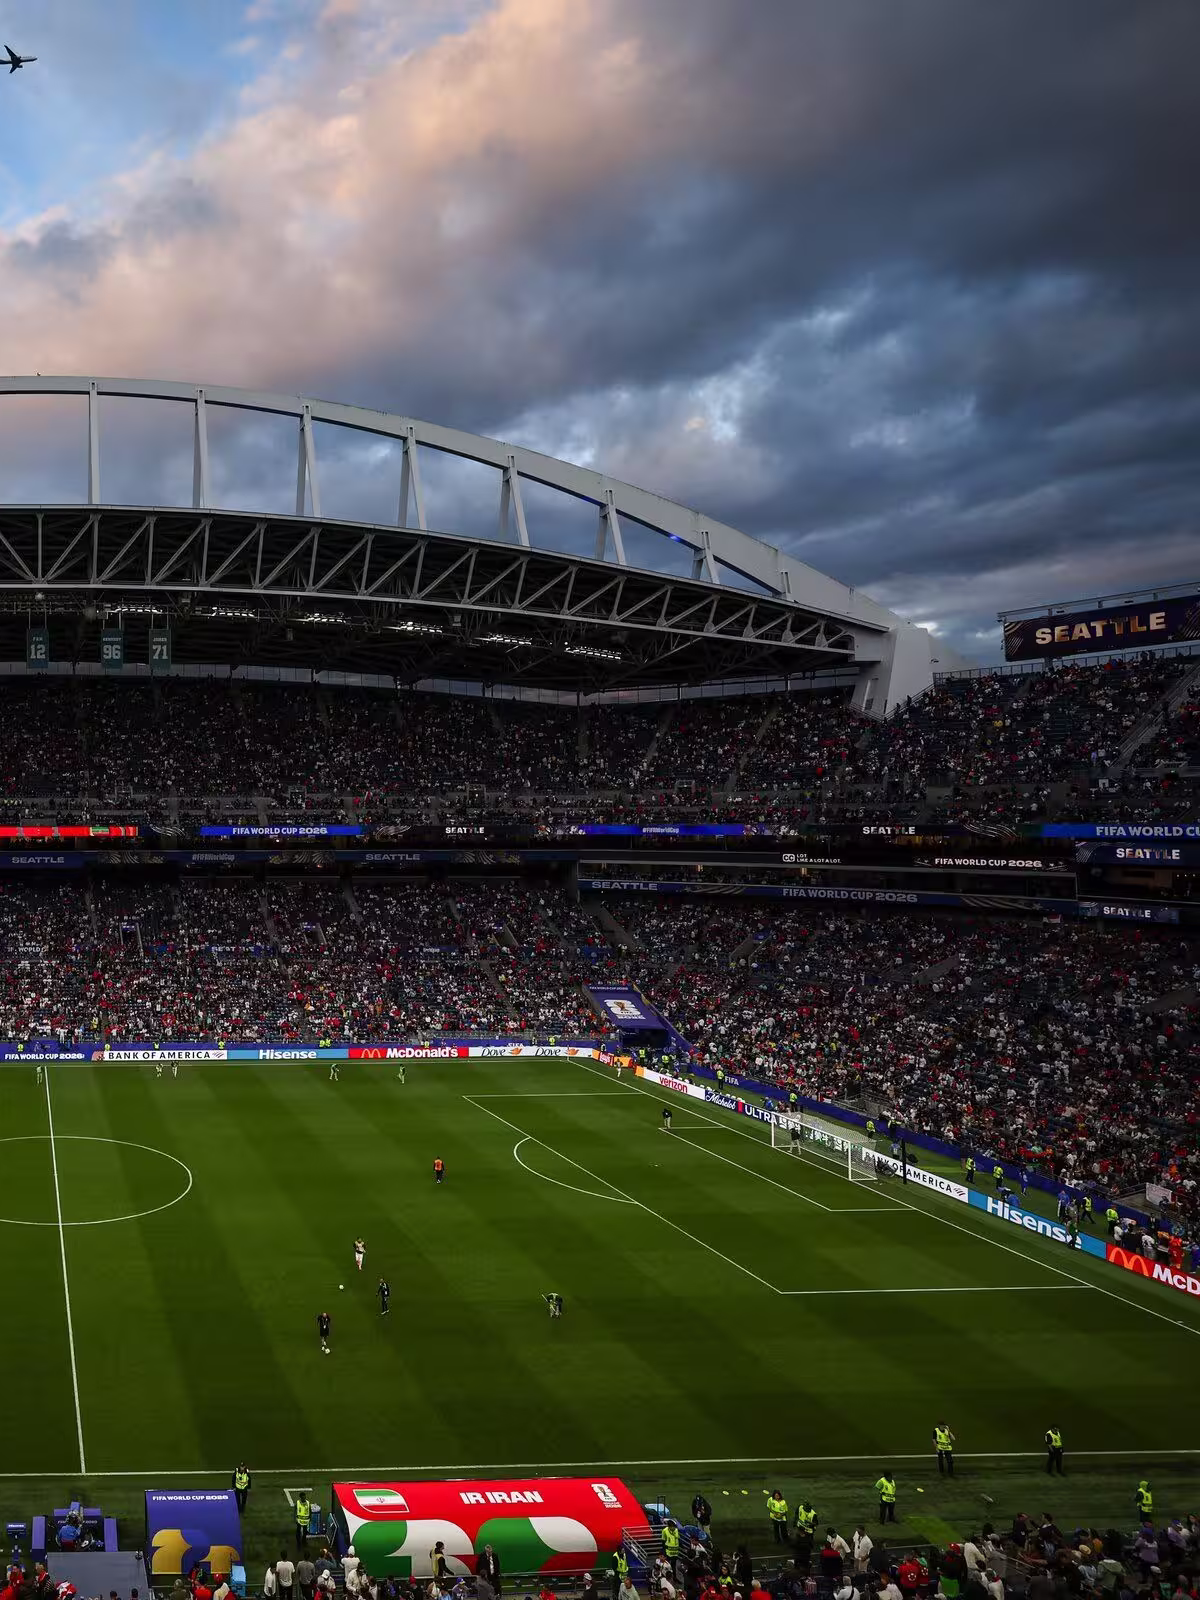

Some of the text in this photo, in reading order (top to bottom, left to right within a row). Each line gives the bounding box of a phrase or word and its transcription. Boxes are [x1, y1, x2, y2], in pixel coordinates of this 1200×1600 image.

[1035, 611, 1167, 645] SEATTLE
[30, 644, 46, 659] 12
[102, 644, 121, 660] 96
[152, 644, 168, 660] 71
[232, 827, 250, 835] FIFA
[250, 827, 280, 835] WORLD
[280, 827, 298, 835] CUP
[445, 826, 485, 834] SEATTLE
[862, 826, 916, 836] SEATTLE
[1096, 826, 1126, 836] FIFA
[1128, 826, 1183, 836] WORLD
[365, 853, 421, 861] SEATTLE
[1116, 848, 1180, 860] SEATTLE
[12, 856, 65, 864] SEATTLE
[934, 858, 1043, 868] FIFA WORLD CUP 2026
[592, 881, 658, 891] SEATTLE
[782, 888, 918, 903] FIFA WORLD CUP 2026
[1103, 906, 1151, 918] SEATTLE
[108, 1051, 211, 1060] BANK OF AMERICA
[259, 1049, 317, 1060] Hisense
[386, 1046, 458, 1058] McDonald's
[481, 1048, 506, 1057] Dove
[535, 1047, 560, 1057] Dove
[659, 1076, 688, 1094] verizon
[724, 1076, 739, 1086] FIFA
[706, 1090, 778, 1125] Michelob ULTRA
[906, 1168, 952, 1192] AMERICA
[459, 1490, 544, 1504] IR IRAN
